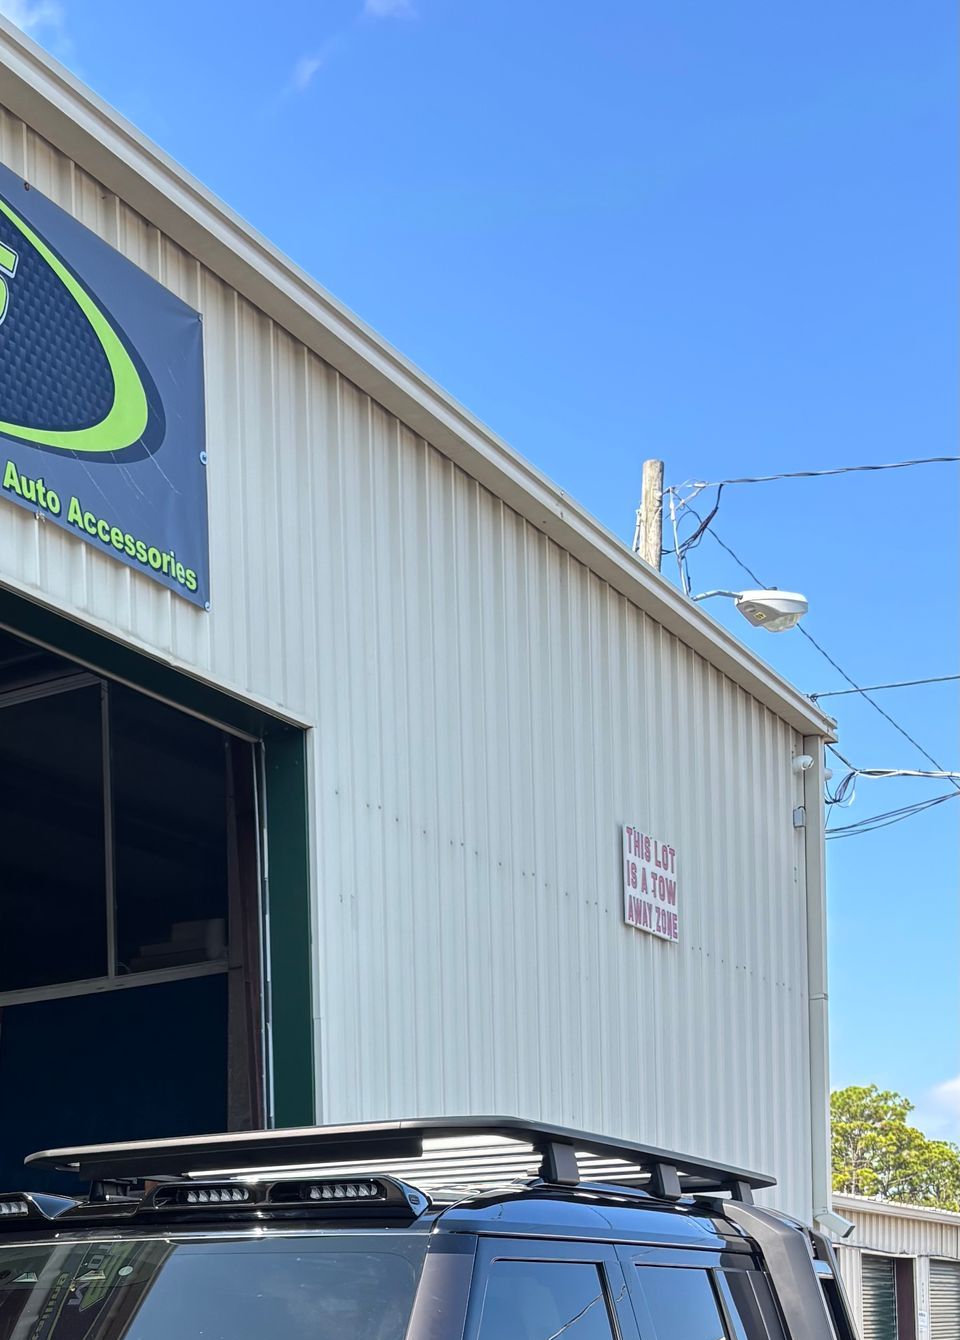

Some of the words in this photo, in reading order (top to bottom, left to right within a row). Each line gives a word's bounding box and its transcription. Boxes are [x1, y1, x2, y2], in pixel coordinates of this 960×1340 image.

[3, 461, 61, 514] Auto
[67, 497, 197, 592] Accessories
[626, 826, 651, 862] THIS
[654, 841, 675, 873] LOT
[627, 860, 637, 889] IS
[641, 867, 648, 894] A
[651, 872, 676, 905] TOW
[628, 895, 652, 929] AWAY
[655, 906, 678, 939] ZONE
